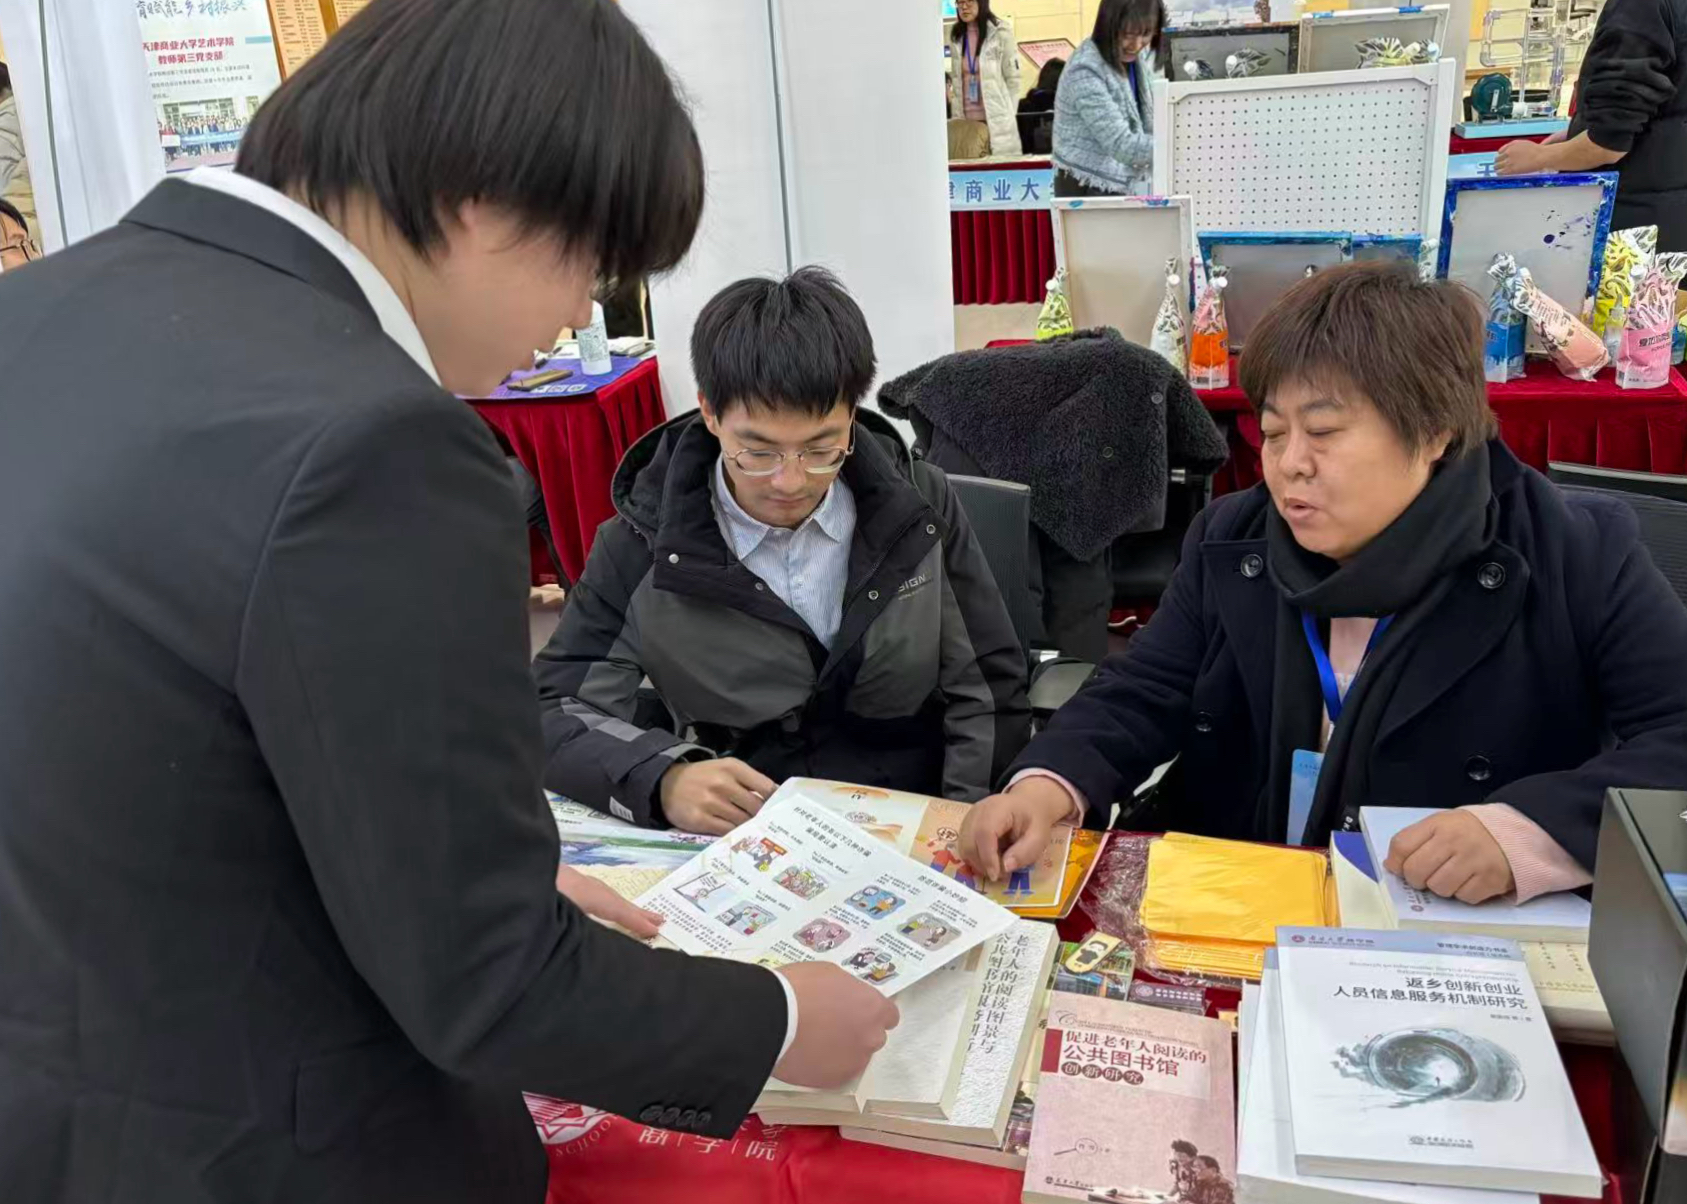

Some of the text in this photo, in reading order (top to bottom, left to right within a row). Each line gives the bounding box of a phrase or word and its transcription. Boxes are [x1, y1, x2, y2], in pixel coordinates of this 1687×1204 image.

[143, 36, 234, 51] 天津商业大学艺术学院
[158, 51, 223, 64] 教师第三党支部
[949, 177, 1054, 203] 商业大
[1406, 977, 1523, 995] 返乡创新创业
[1334, 986, 1528, 1009] 人员信息服务机制研究
[1066, 1030, 1206, 1063] 促进老年人阅读的
[1063, 1044, 1180, 1077] 公共图书馆
[1064, 1063, 1144, 1085] 创新研究
